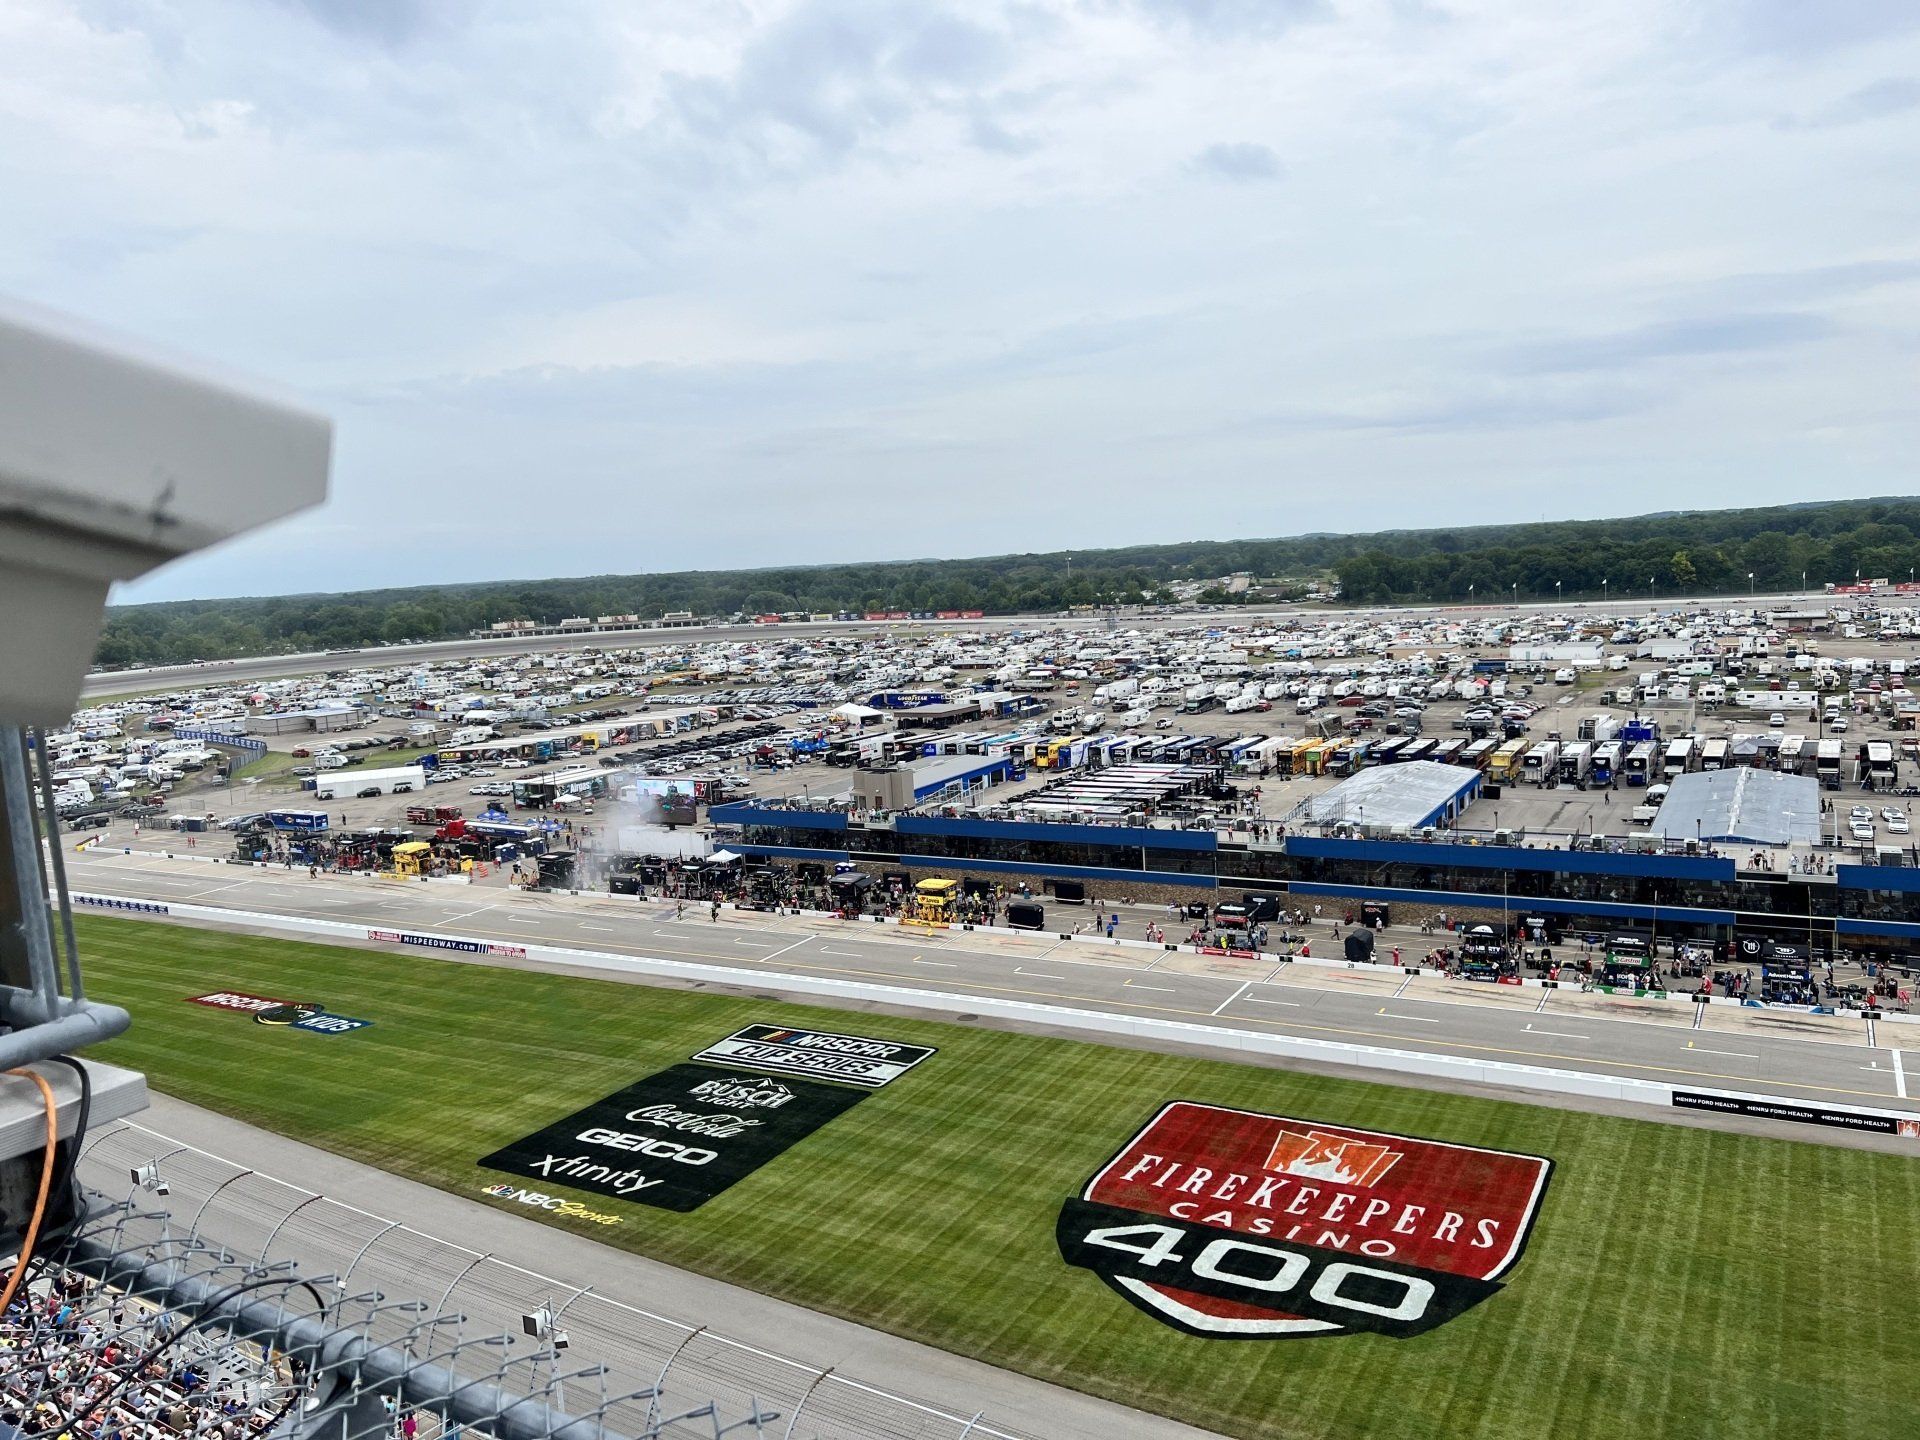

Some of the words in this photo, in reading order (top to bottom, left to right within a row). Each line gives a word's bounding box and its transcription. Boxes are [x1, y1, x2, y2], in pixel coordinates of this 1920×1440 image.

[570, 782, 591, 795] Airgas
[403, 936, 475, 951] MISPEEDWAY.com
[197, 993, 284, 1011] NASCAR
[297, 1015, 362, 1032] KIDS
[790, 1034, 902, 1058] NASCAR
[731, 1044, 790, 1063] CUP
[790, 1051, 883, 1074] SERIES
[686, 1080, 797, 1109] BUSCH
[695, 1095, 756, 1109] LIGHT
[1675, 1096, 1697, 1104] HENRY
[1714, 1101, 1740, 1109] HEALTH
[1746, 1105, 1769, 1113] HENRY
[1787, 1110, 1813, 1119] HEALTH
[1821, 1114, 1845, 1122] HENRY
[1845, 1117, 1863, 1125] FORD
[1863, 1120, 1890, 1128] HEALTH
[575, 1127, 719, 1166] GEICO
[529, 1154, 665, 1194] xfinity
[506, 1189, 566, 1210] NBC
[552, 1202, 624, 1226] Sports
[1119, 1153, 1501, 1249] FIREKEEPERS
[1169, 1202, 1396, 1257] CASINO
[1083, 1223, 1436, 1322] 400
